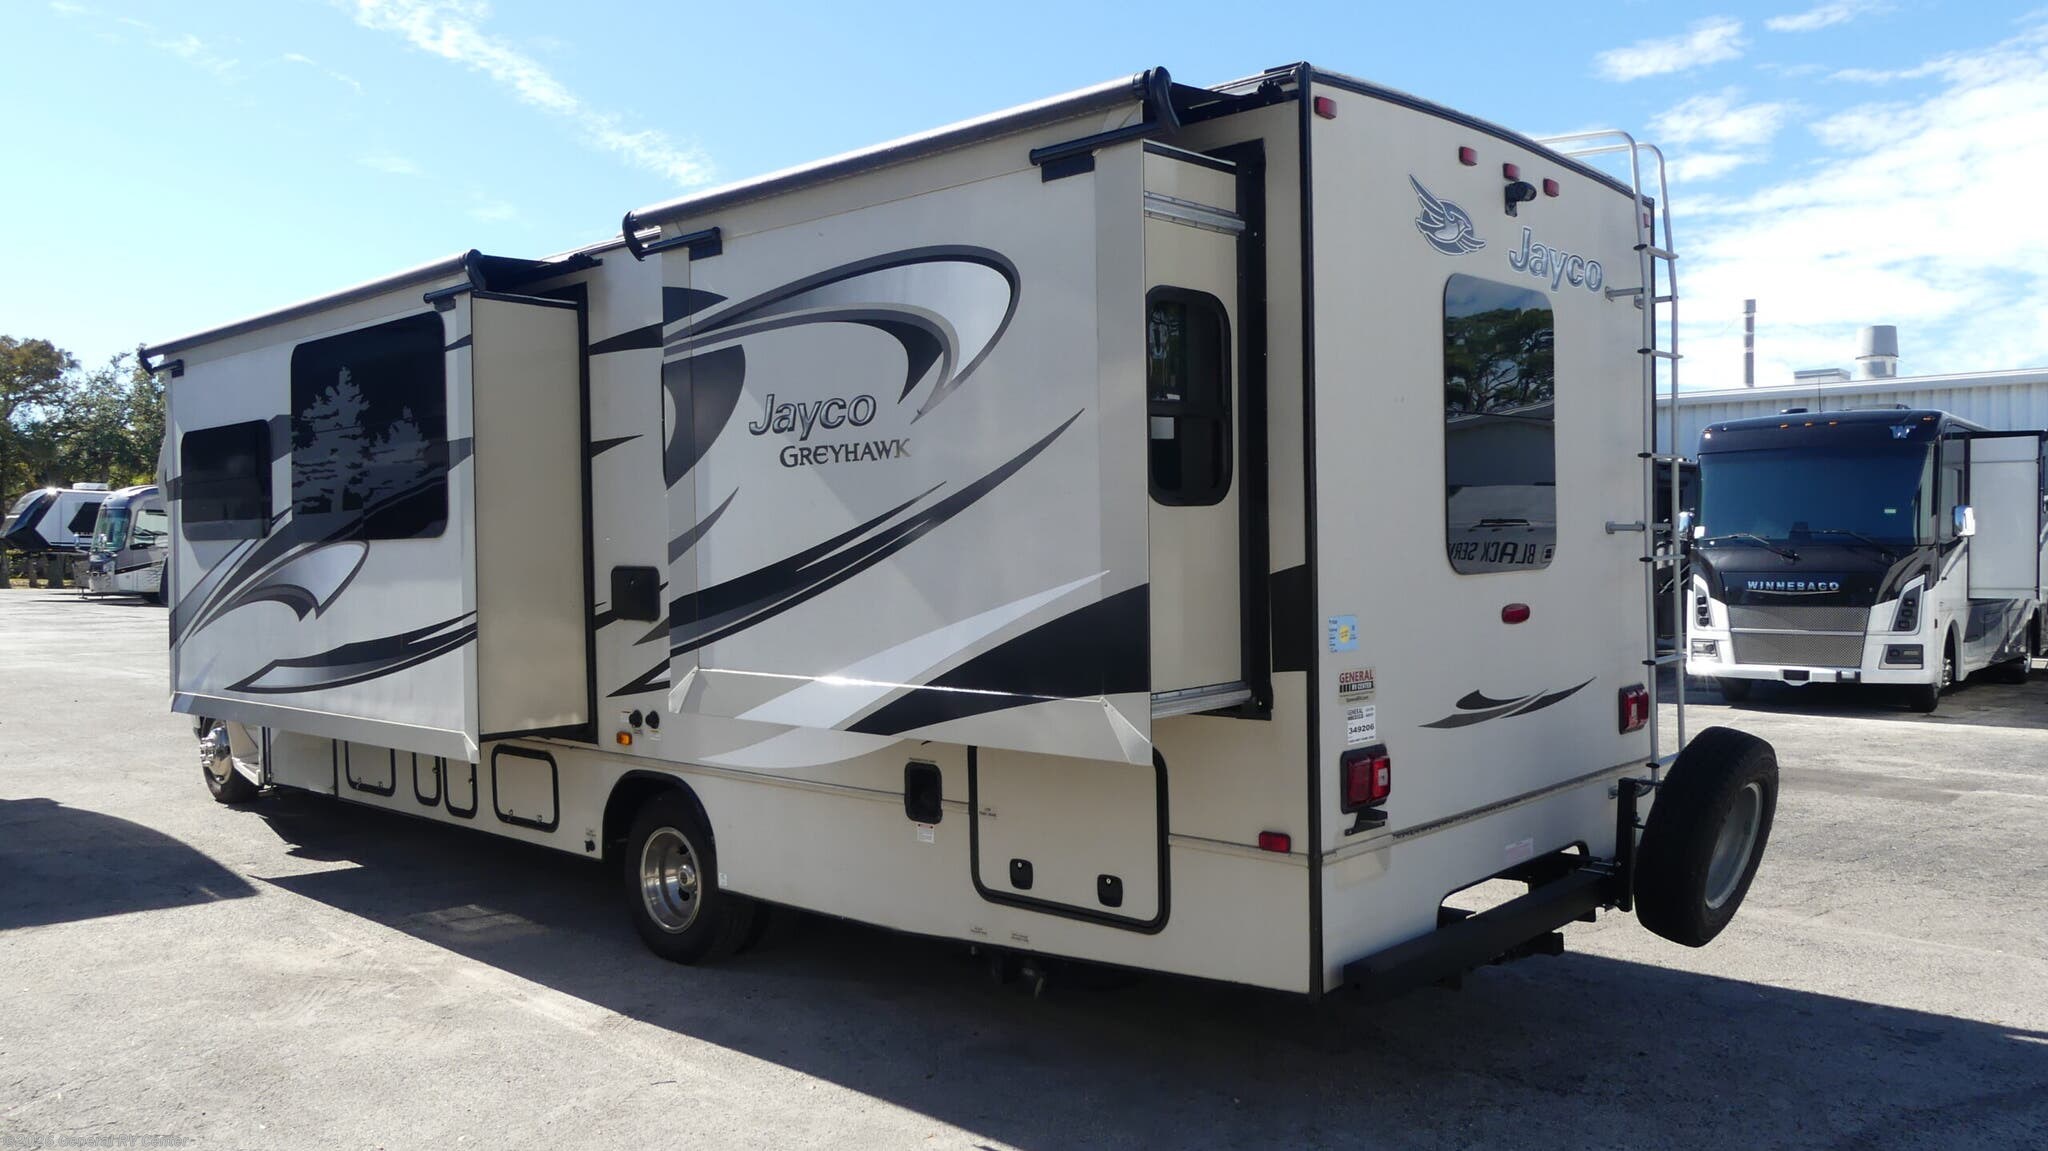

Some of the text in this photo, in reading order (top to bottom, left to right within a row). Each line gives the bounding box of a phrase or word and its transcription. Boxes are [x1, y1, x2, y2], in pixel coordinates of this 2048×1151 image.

[1508, 226, 1603, 293] Jayco
[748, 393, 877, 441] Jayco
[779, 438, 911, 468] GREYHAWK
[1747, 580, 1840, 591] WINNEBAGO
[1339, 669, 1374, 684] GENERAL
[1348, 723, 1375, 735] 349206
